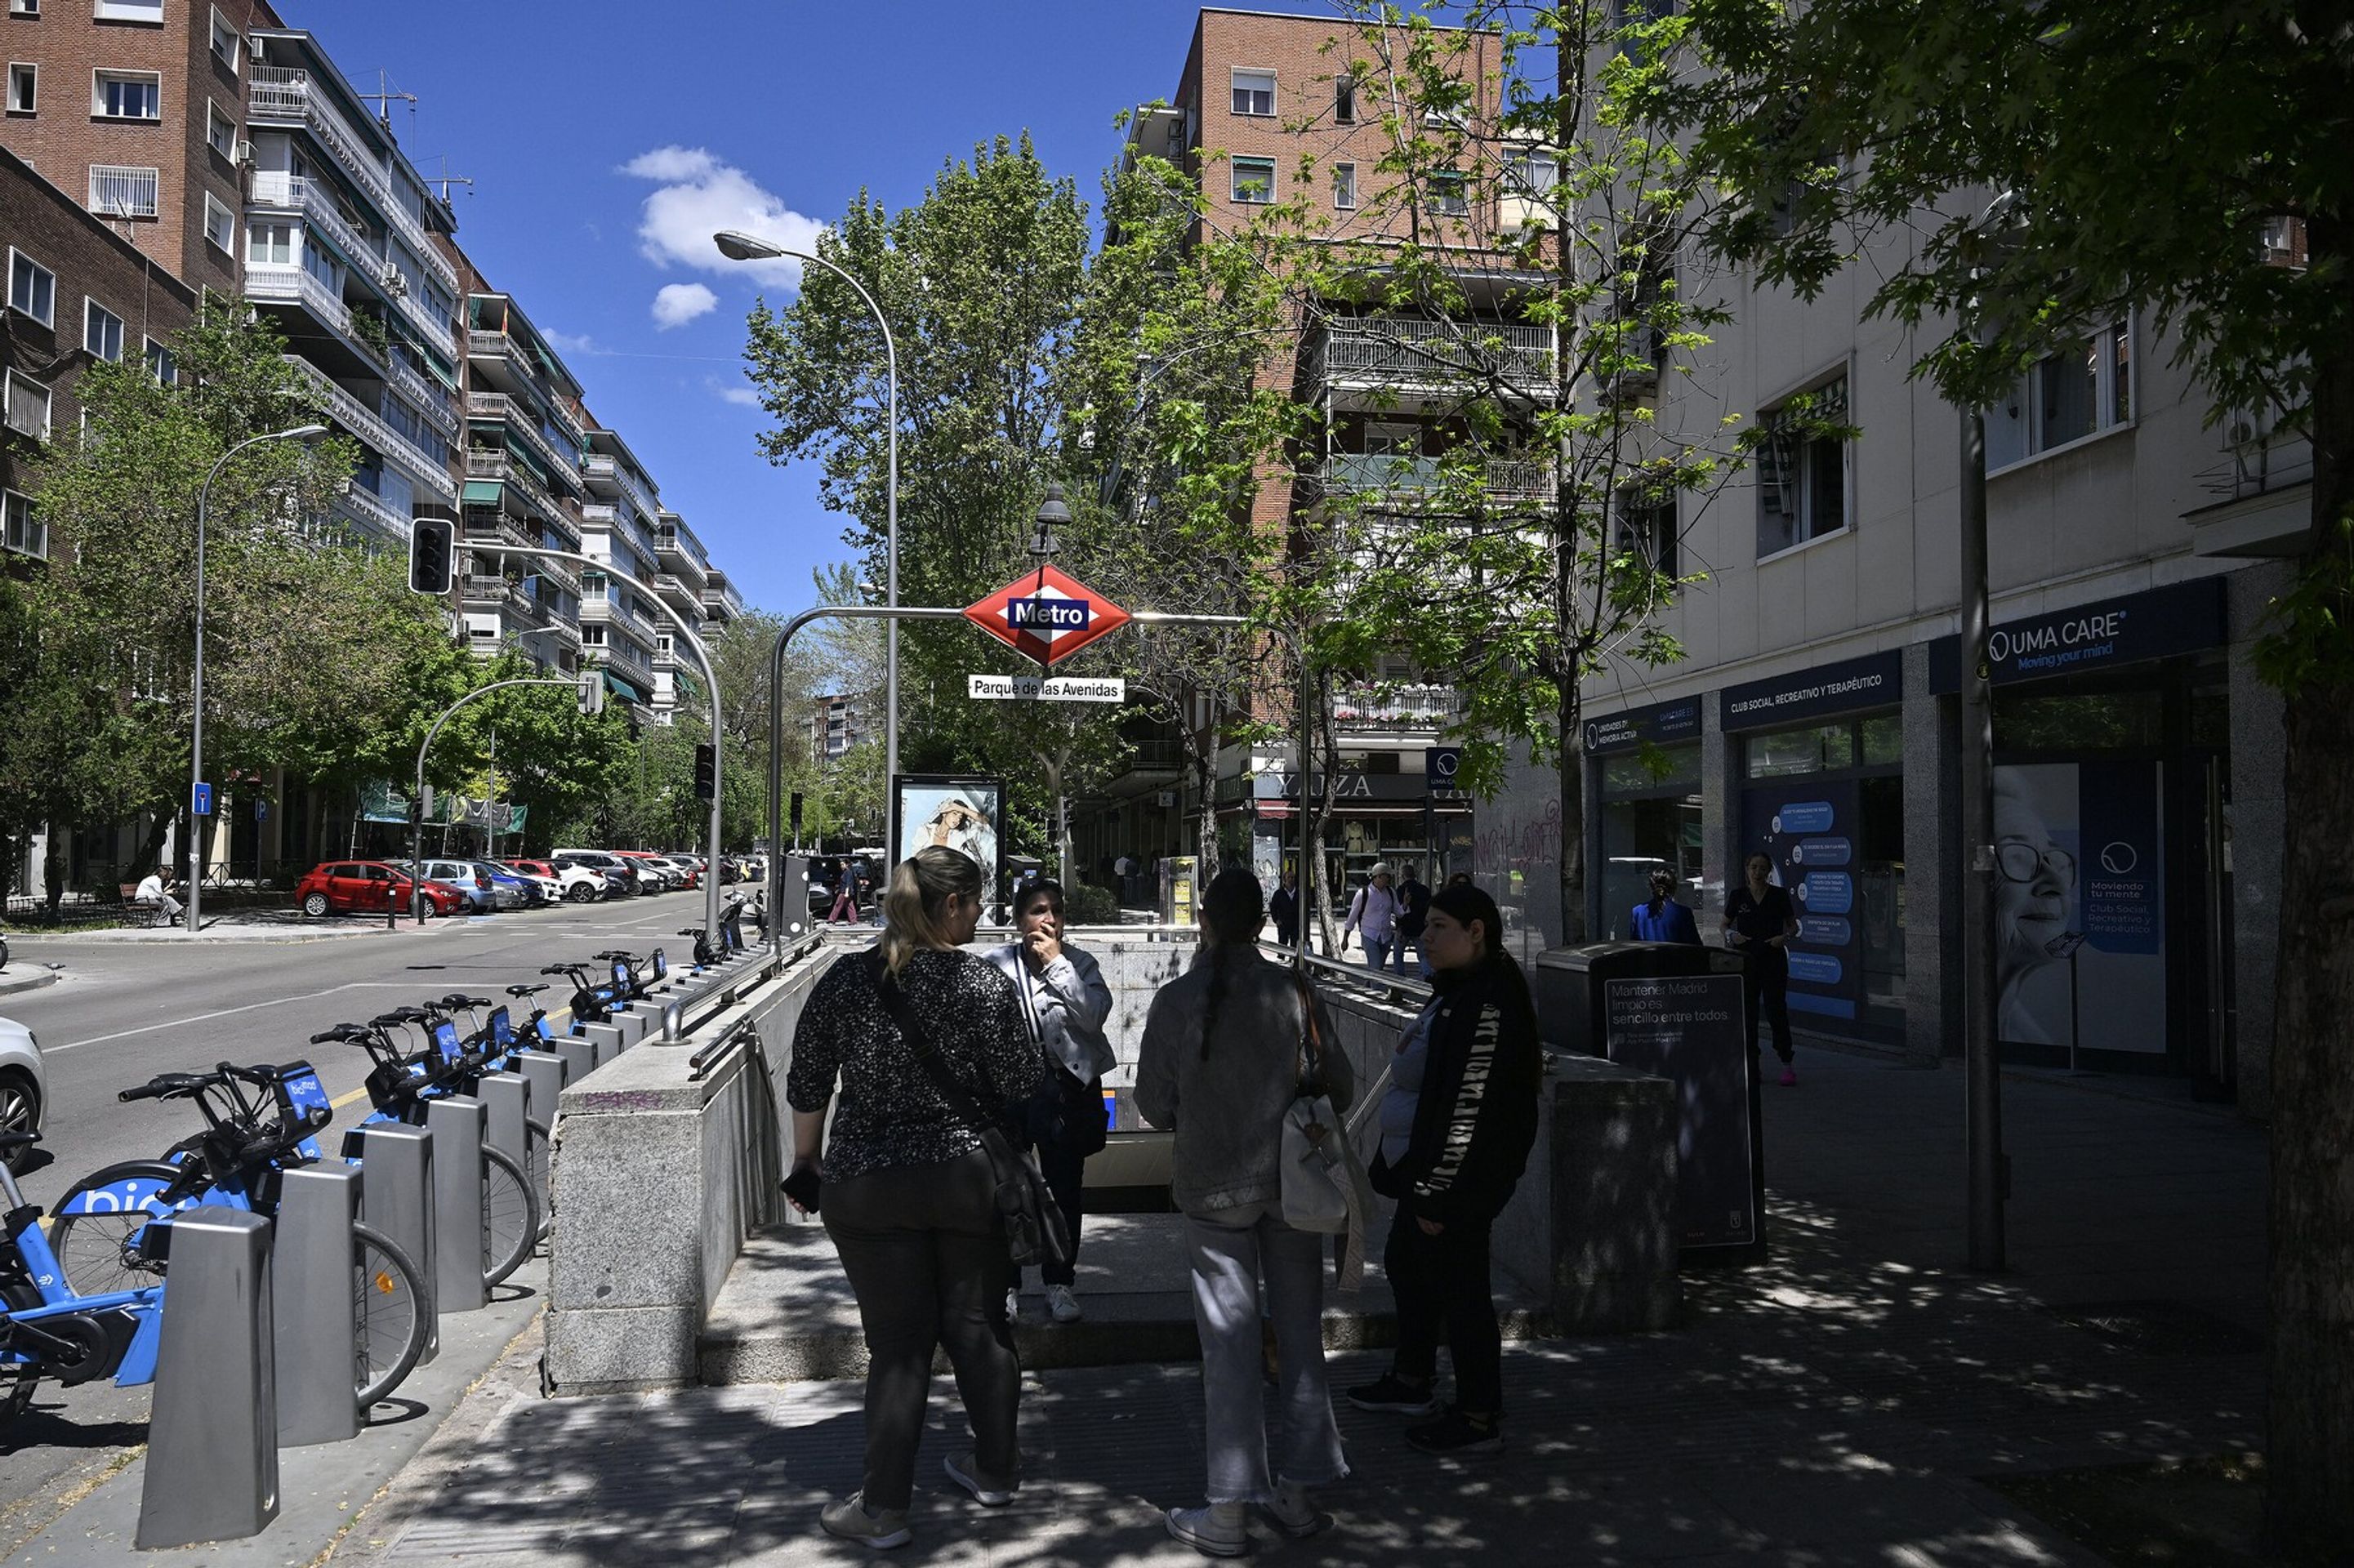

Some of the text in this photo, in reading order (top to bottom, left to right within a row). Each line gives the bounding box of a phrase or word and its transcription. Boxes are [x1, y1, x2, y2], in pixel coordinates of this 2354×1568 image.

[1015, 603, 1083, 625] Metro
[2012, 626, 2058, 654] UMA
[2017, 641, 2113, 671] Moving your mind
[974, 679, 1118, 697] Parque de las Avenidas
[1731, 675, 1883, 715] CLUB SOCIAL, RECREATIVO Y TERAPÉUTICO
[2091, 882, 2143, 890] Moviendo
[2091, 890, 2141, 899] tu mente
[2089, 904, 2114, 913] Club
[2089, 915, 2151, 925] Recreativo y
[2089, 924, 2150, 933] Terapéutico
[1612, 982, 1709, 996] Mantener Madrid
[1612, 999, 1663, 1012] limpio es
[1612, 1012, 1659, 1026] sencillo
[1661, 1011, 1692, 1023] entre
